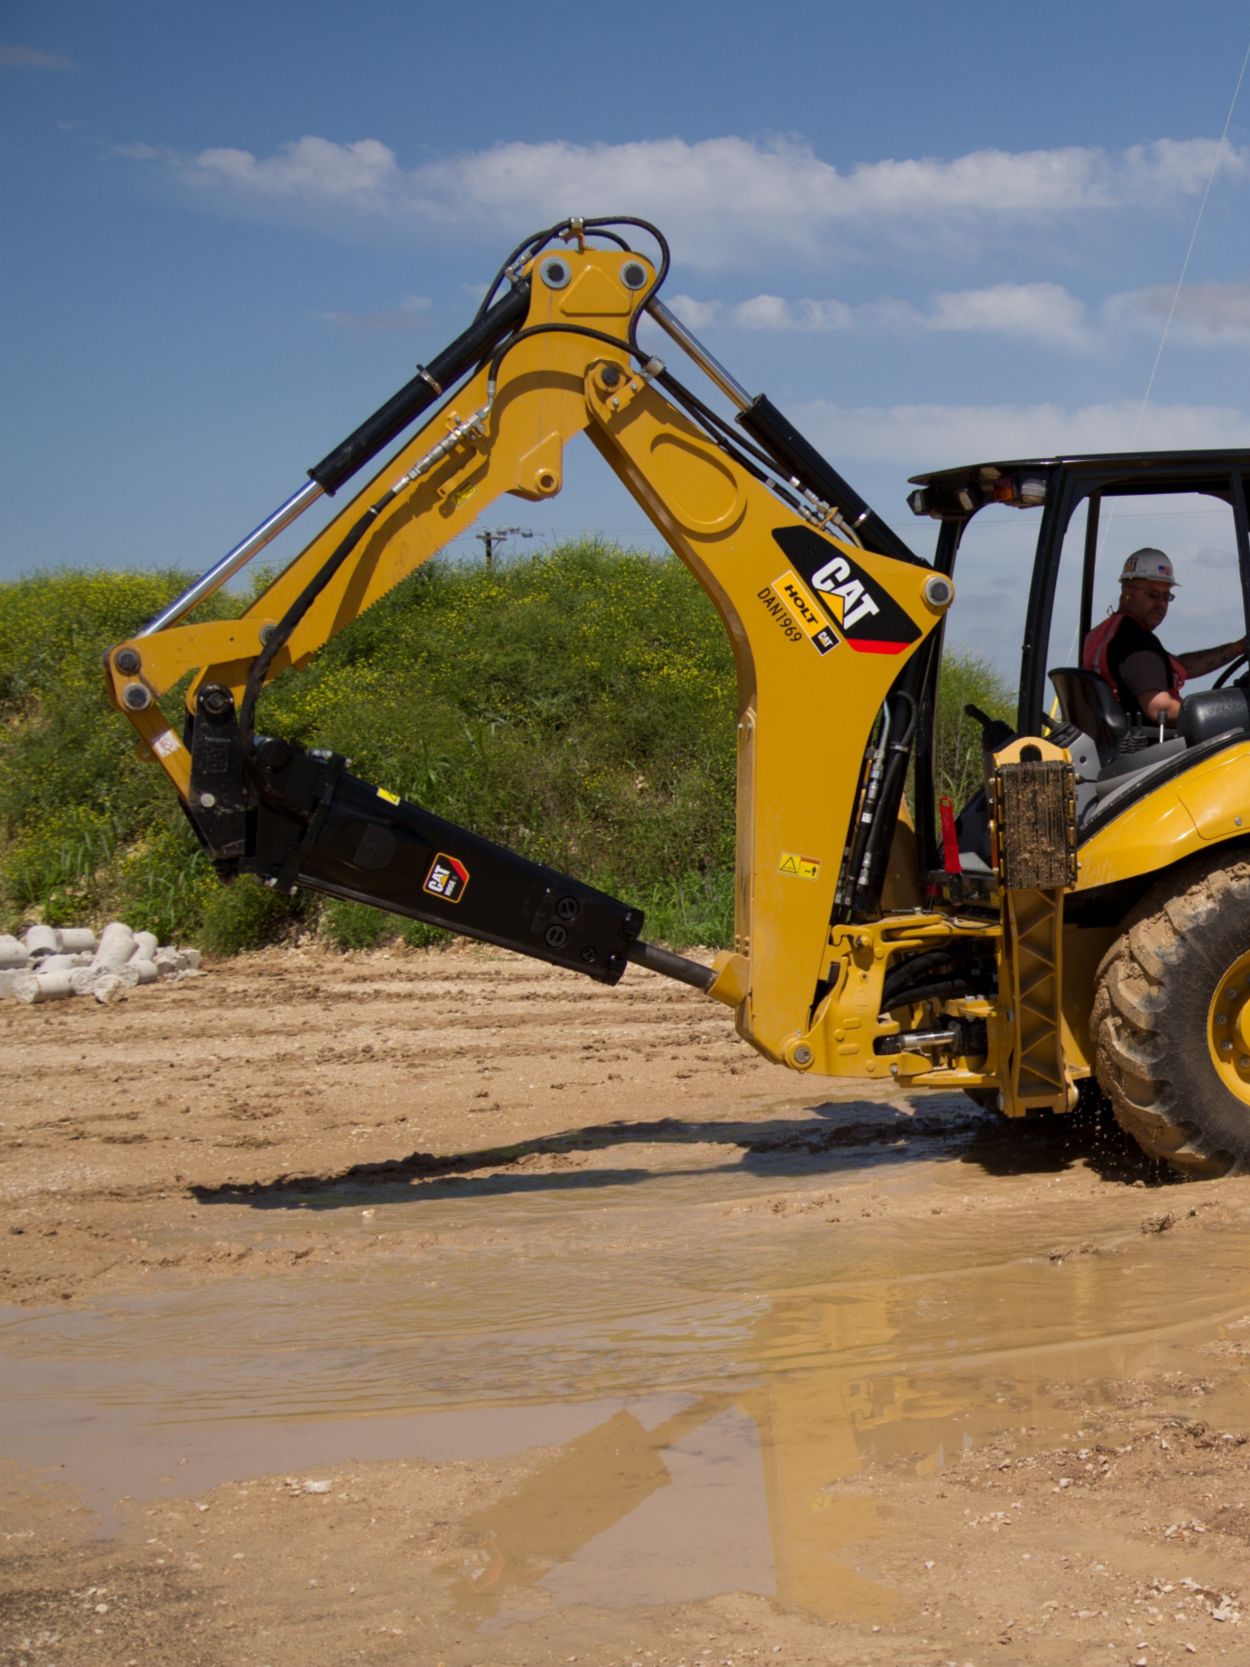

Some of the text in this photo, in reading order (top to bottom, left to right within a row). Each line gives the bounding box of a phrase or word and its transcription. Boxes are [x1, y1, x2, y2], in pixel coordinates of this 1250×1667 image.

[757, 587, 802, 642] DAN1969
[784, 584, 834, 648] HOLT CAT
[812, 557, 880, 630] CAT
[428, 864, 450, 892] CAT
